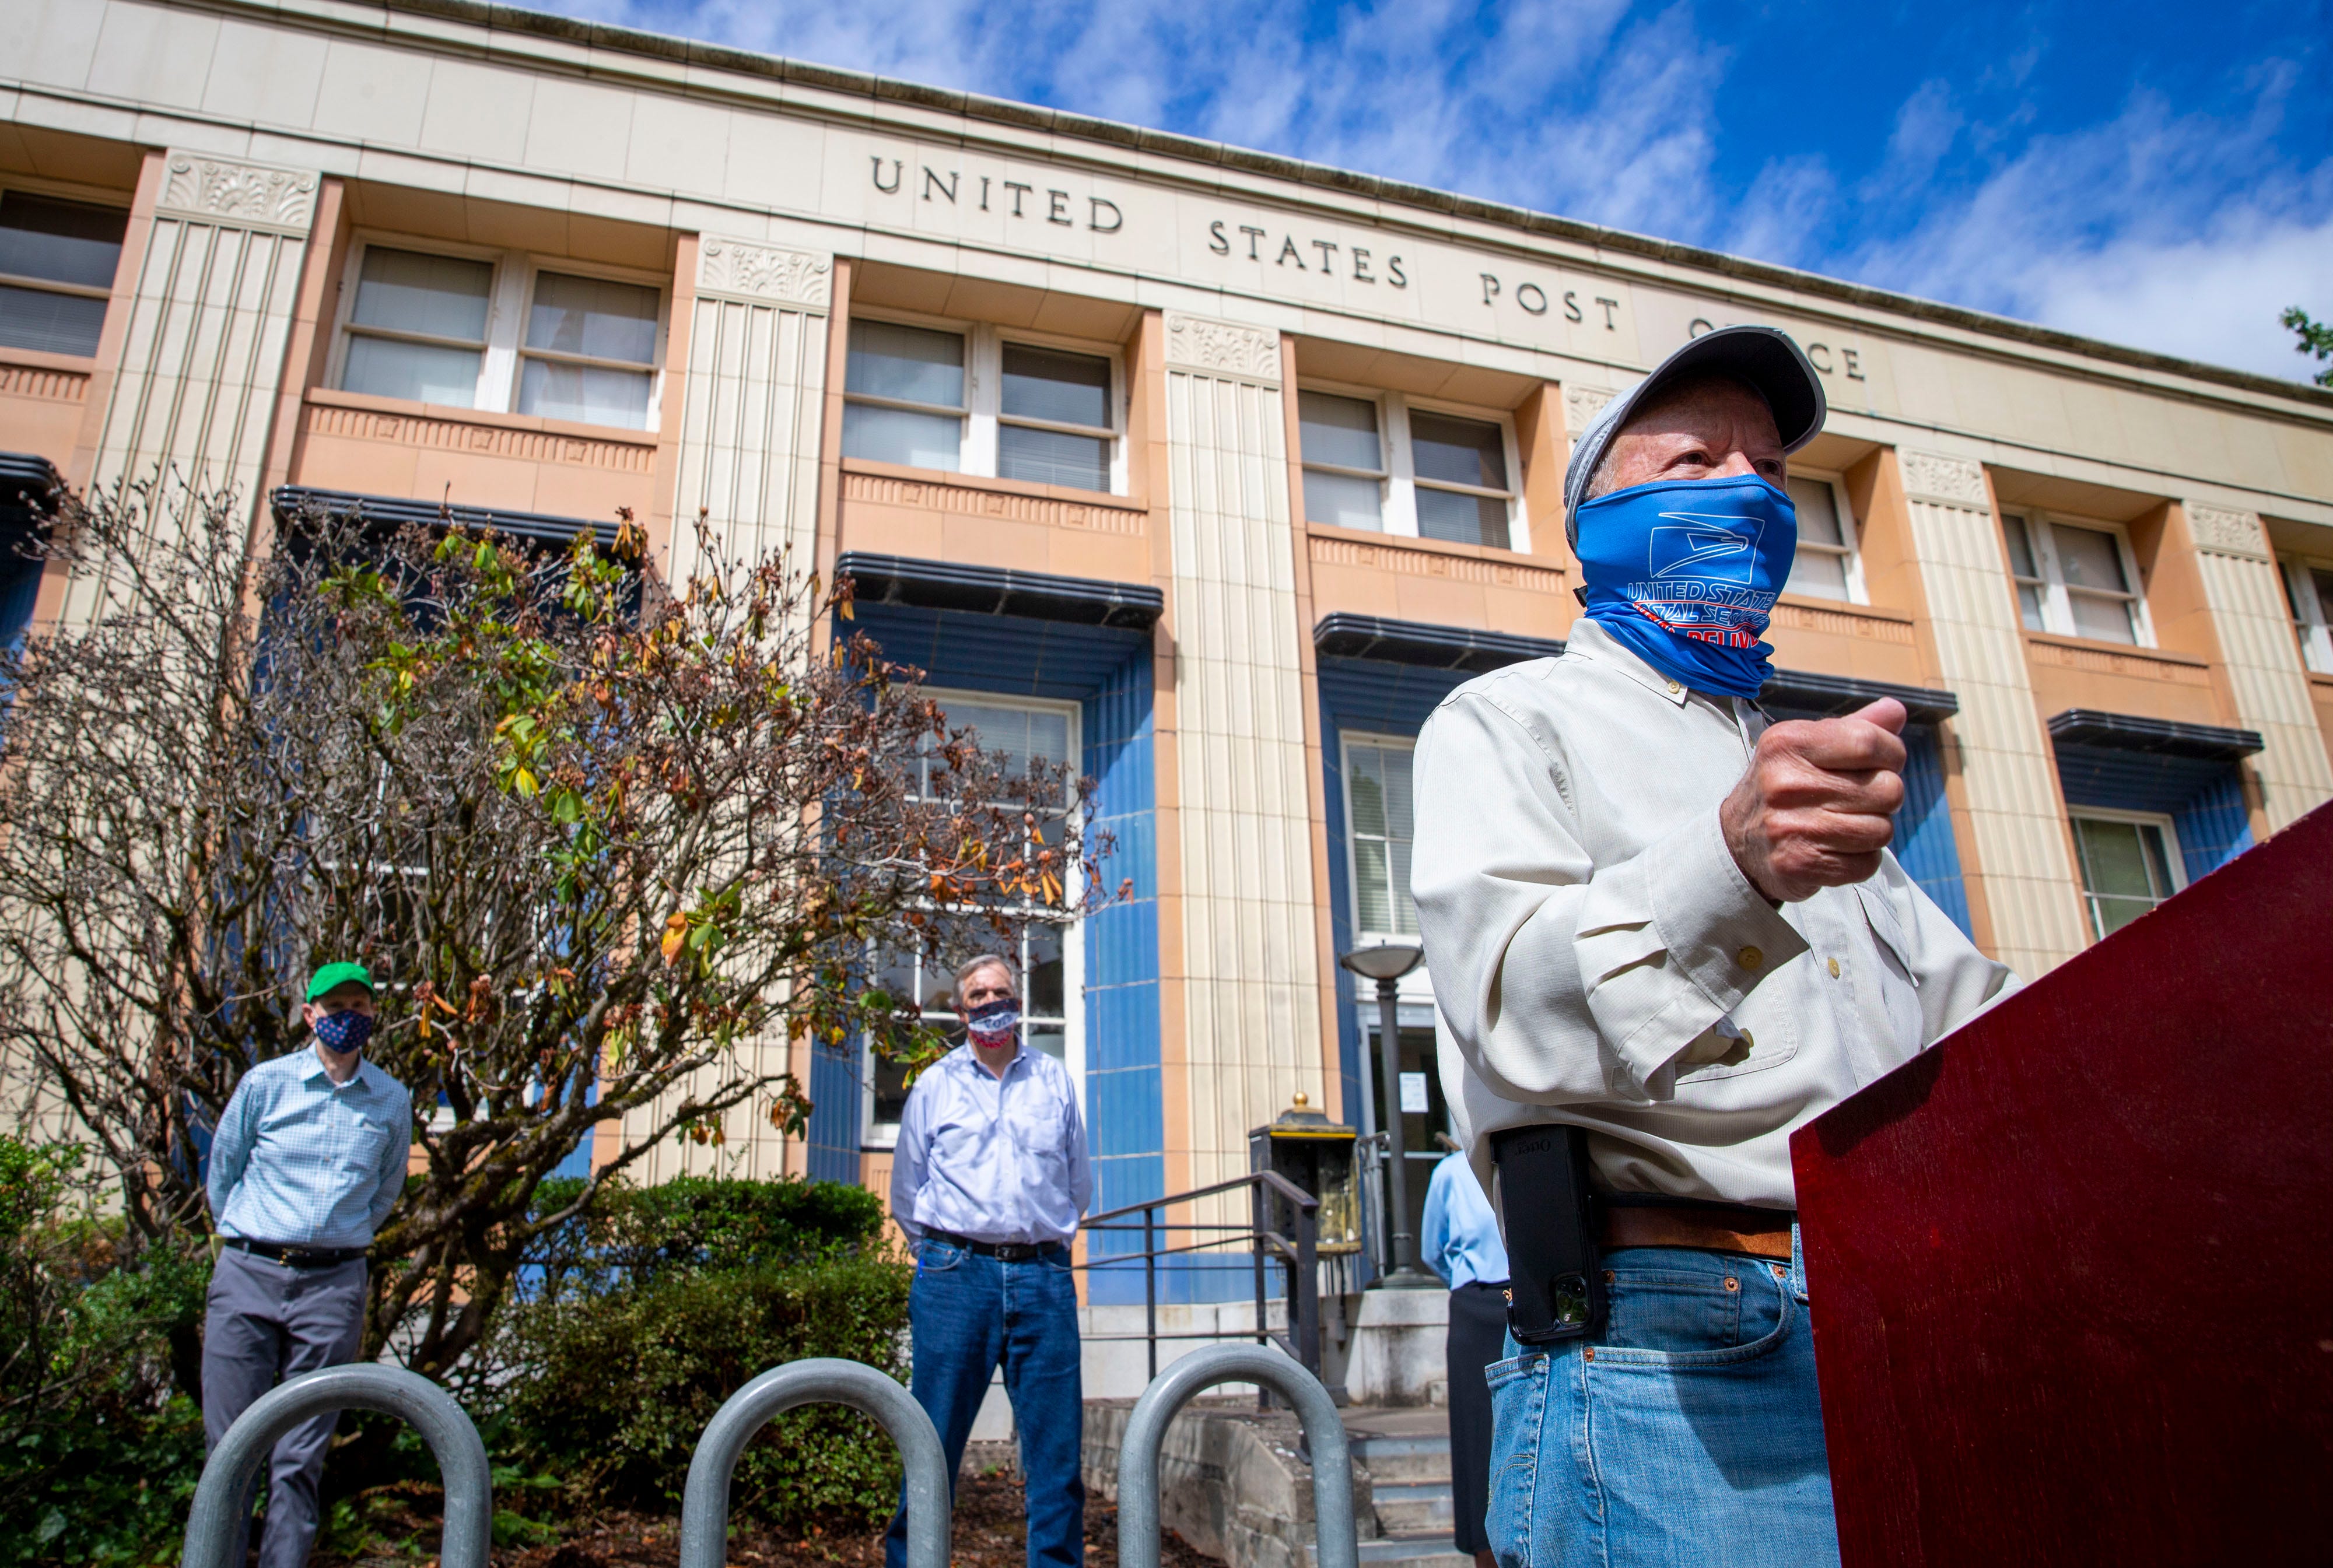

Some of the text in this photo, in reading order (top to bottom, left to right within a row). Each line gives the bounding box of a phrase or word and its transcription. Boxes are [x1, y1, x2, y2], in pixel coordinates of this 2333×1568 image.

[870, 156, 1865, 383] UNITED STATES POST OCE
[1627, 581, 1775, 611] UNITED STATE
